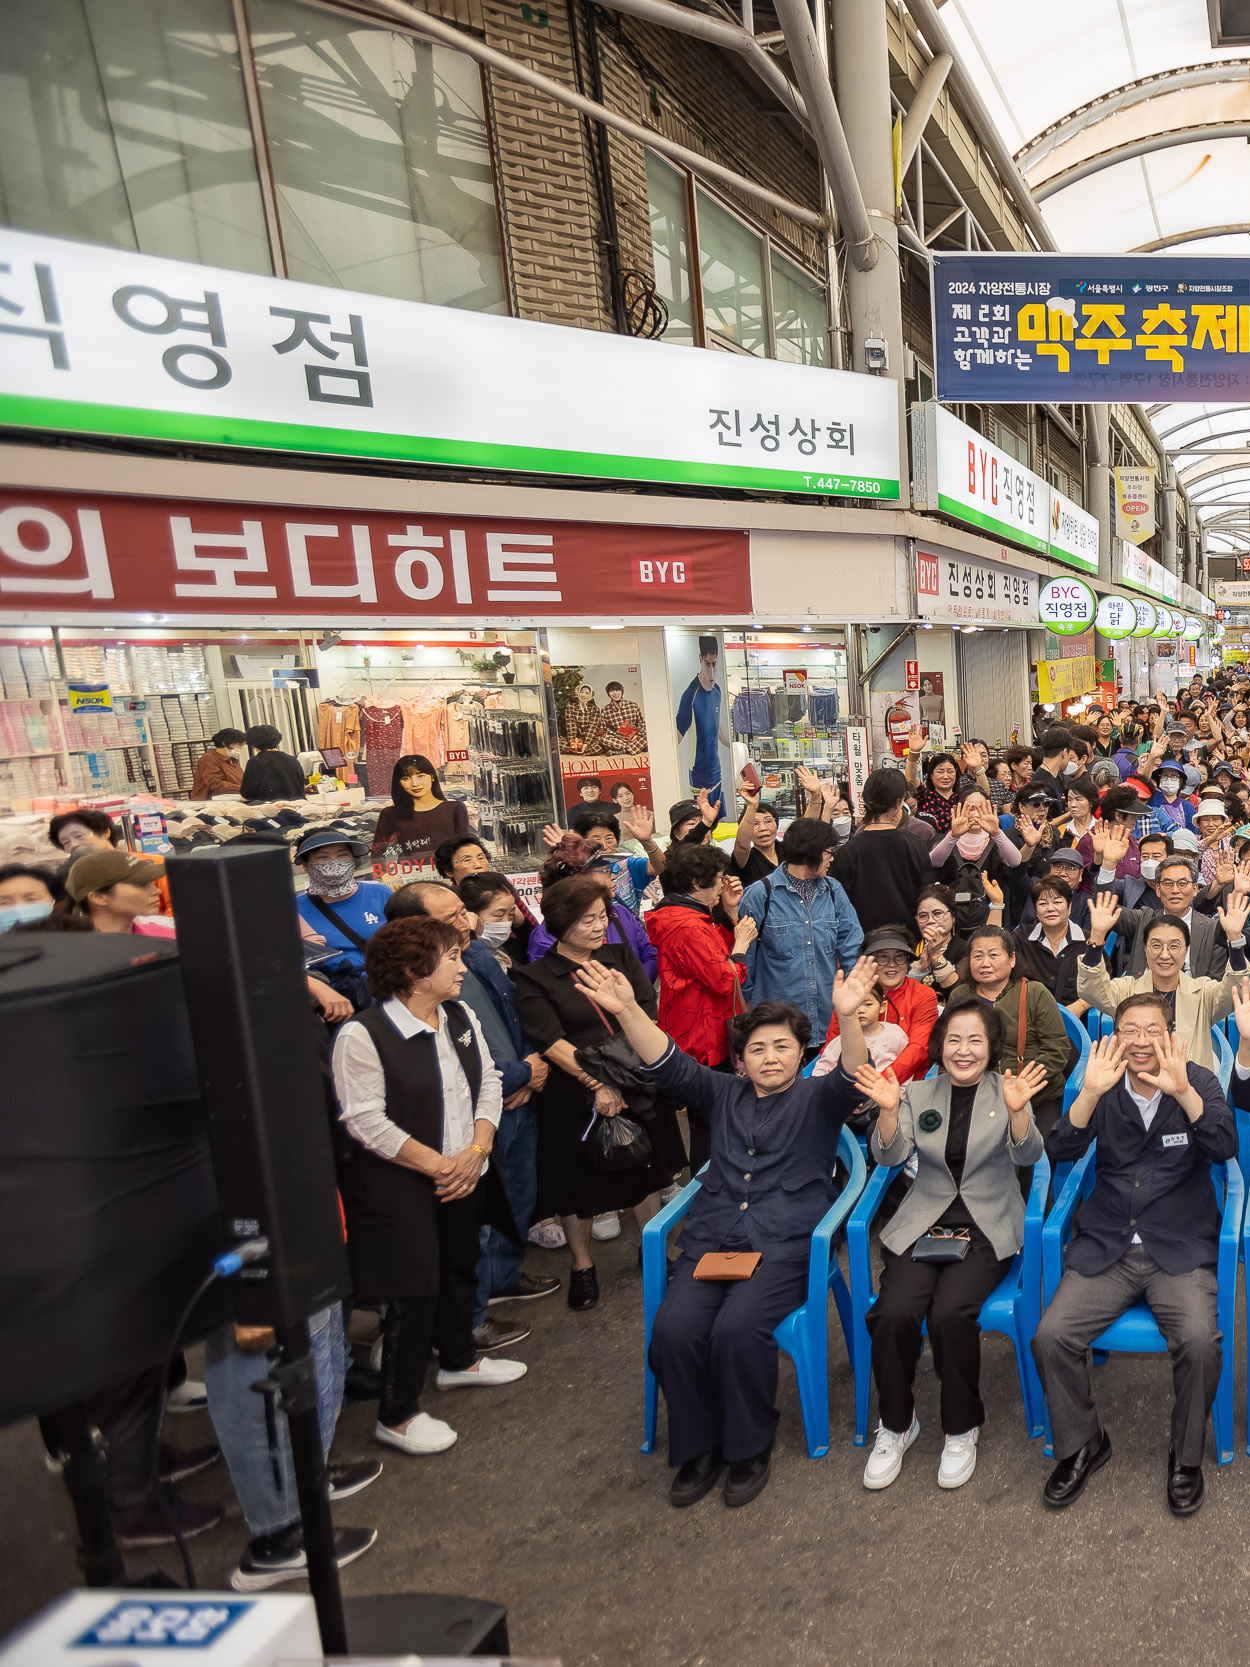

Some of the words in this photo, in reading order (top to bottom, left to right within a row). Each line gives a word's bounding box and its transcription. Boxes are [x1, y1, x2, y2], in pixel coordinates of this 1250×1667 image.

[948, 282, 976, 294] 2024
[979, 282, 1051, 296] 자양전통시장
[1087, 284, 1123, 294] 서울특별시
[1145, 285, 1169, 293] 광진구
[951, 304, 971, 320] 제
[979, 304, 1010, 322] 2회
[953, 327, 1012, 348] 고객과
[1017, 302, 1132, 372] 맥주
[1136, 303, 1250, 372] 축제
[953, 348, 1033, 371] 함께하는
[708, 408, 856, 456] 진성상회
[967, 439, 998, 506] BYC
[803, 476, 881, 494] T.447-7850
[1003, 465, 1036, 525] 직영점
[169, 515, 563, 604] 보디히트
[639, 560, 686, 584] BYC
[920, 560, 937, 591] BYC
[948, 562, 996, 600] 진성상회
[1003, 575, 1028, 606] 직영점
[1051, 587, 1080, 599] BYC
[1045, 602, 1087, 618] 직영점
[1107, 602, 1124, 612] 하림
[1109, 612, 1121, 626] 닭
[852, 732, 862, 757] 타월
[449, 751, 467, 760] BYC
[561, 759, 602, 774] HOME
[606, 756, 650, 770] WEAR
[854, 762, 863, 786] 맞춤
[372, 857, 425, 879] BODY
[364, 912, 379, 924] LA
